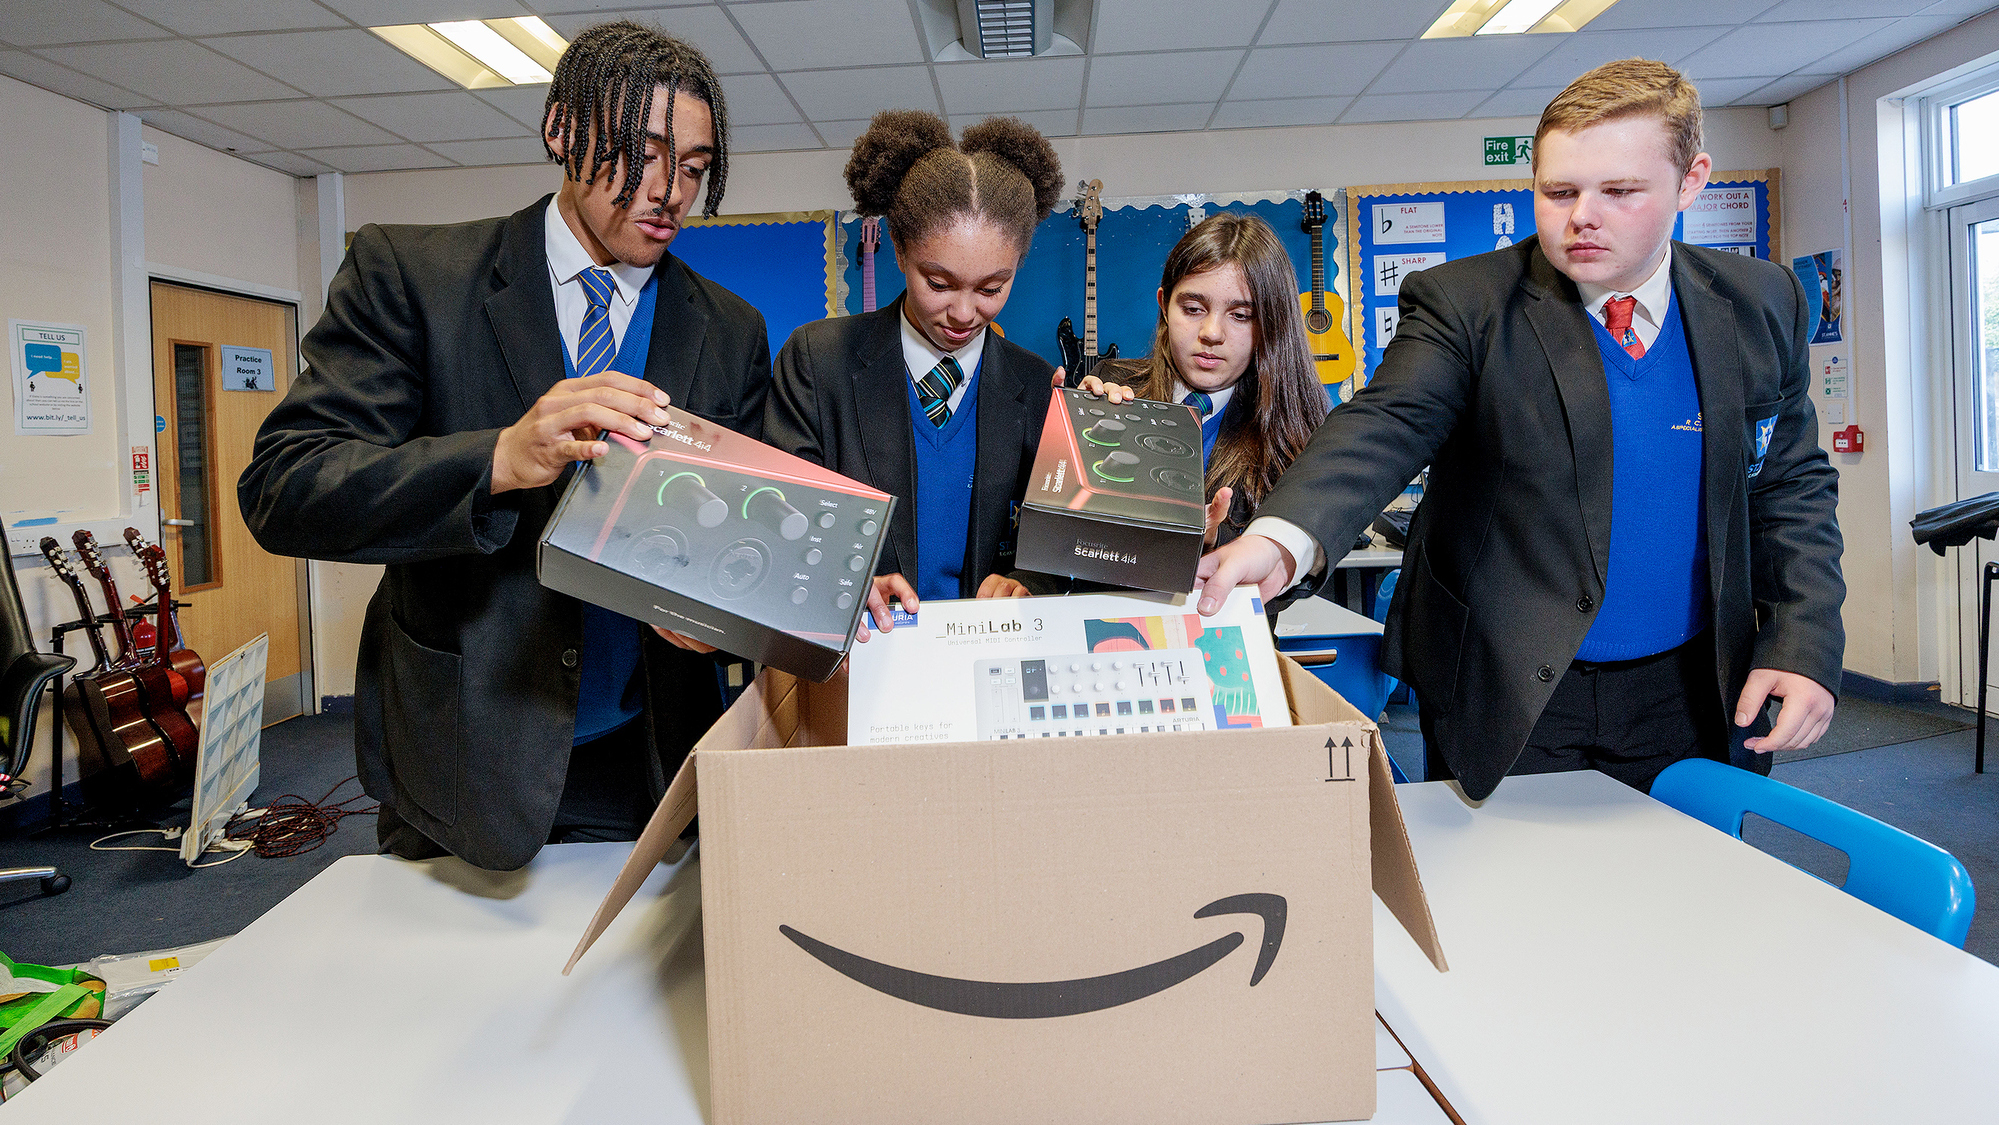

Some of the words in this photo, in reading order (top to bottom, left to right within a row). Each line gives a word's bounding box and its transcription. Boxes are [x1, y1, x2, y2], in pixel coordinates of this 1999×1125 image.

[1486, 140, 1509, 151] Fire
[1486, 152, 1509, 162] exit
[1700, 193, 1724, 201] WORK
[1726, 192, 1741, 200] OUT
[1689, 203, 1718, 212] MAJOR
[1720, 202, 1749, 210] CHORD
[1401, 257, 1427, 265] SHARP
[39, 333, 55, 341] TELL
[235, 354, 262, 364] Practice
[236, 367, 256, 375] Room
[26, 414, 86, 423] www.bit.ly/_tell_us
[693, 440, 712, 453] 4i4
[740, 484, 748, 492] 2
[819, 498, 839, 509] Select
[863, 508, 878, 516] 48V
[809, 535, 823, 543] Inst
[1076, 538, 1109, 550] Focusrite
[852, 542, 864, 550] Air
[1073, 545, 1120, 563] Scarlett
[792, 571, 810, 581] Auto
[838, 578, 854, 587] Safe
[1033, 618, 1044, 632] 3
[947, 638, 982, 646] Universal
[1004, 635, 1043, 643] Controller
[870, 724, 910, 733] Portable
[913, 723, 934, 732] keys
[939, 721, 953, 729] for
[870, 735, 900, 744] modern
[904, 732, 949, 742] creatives
